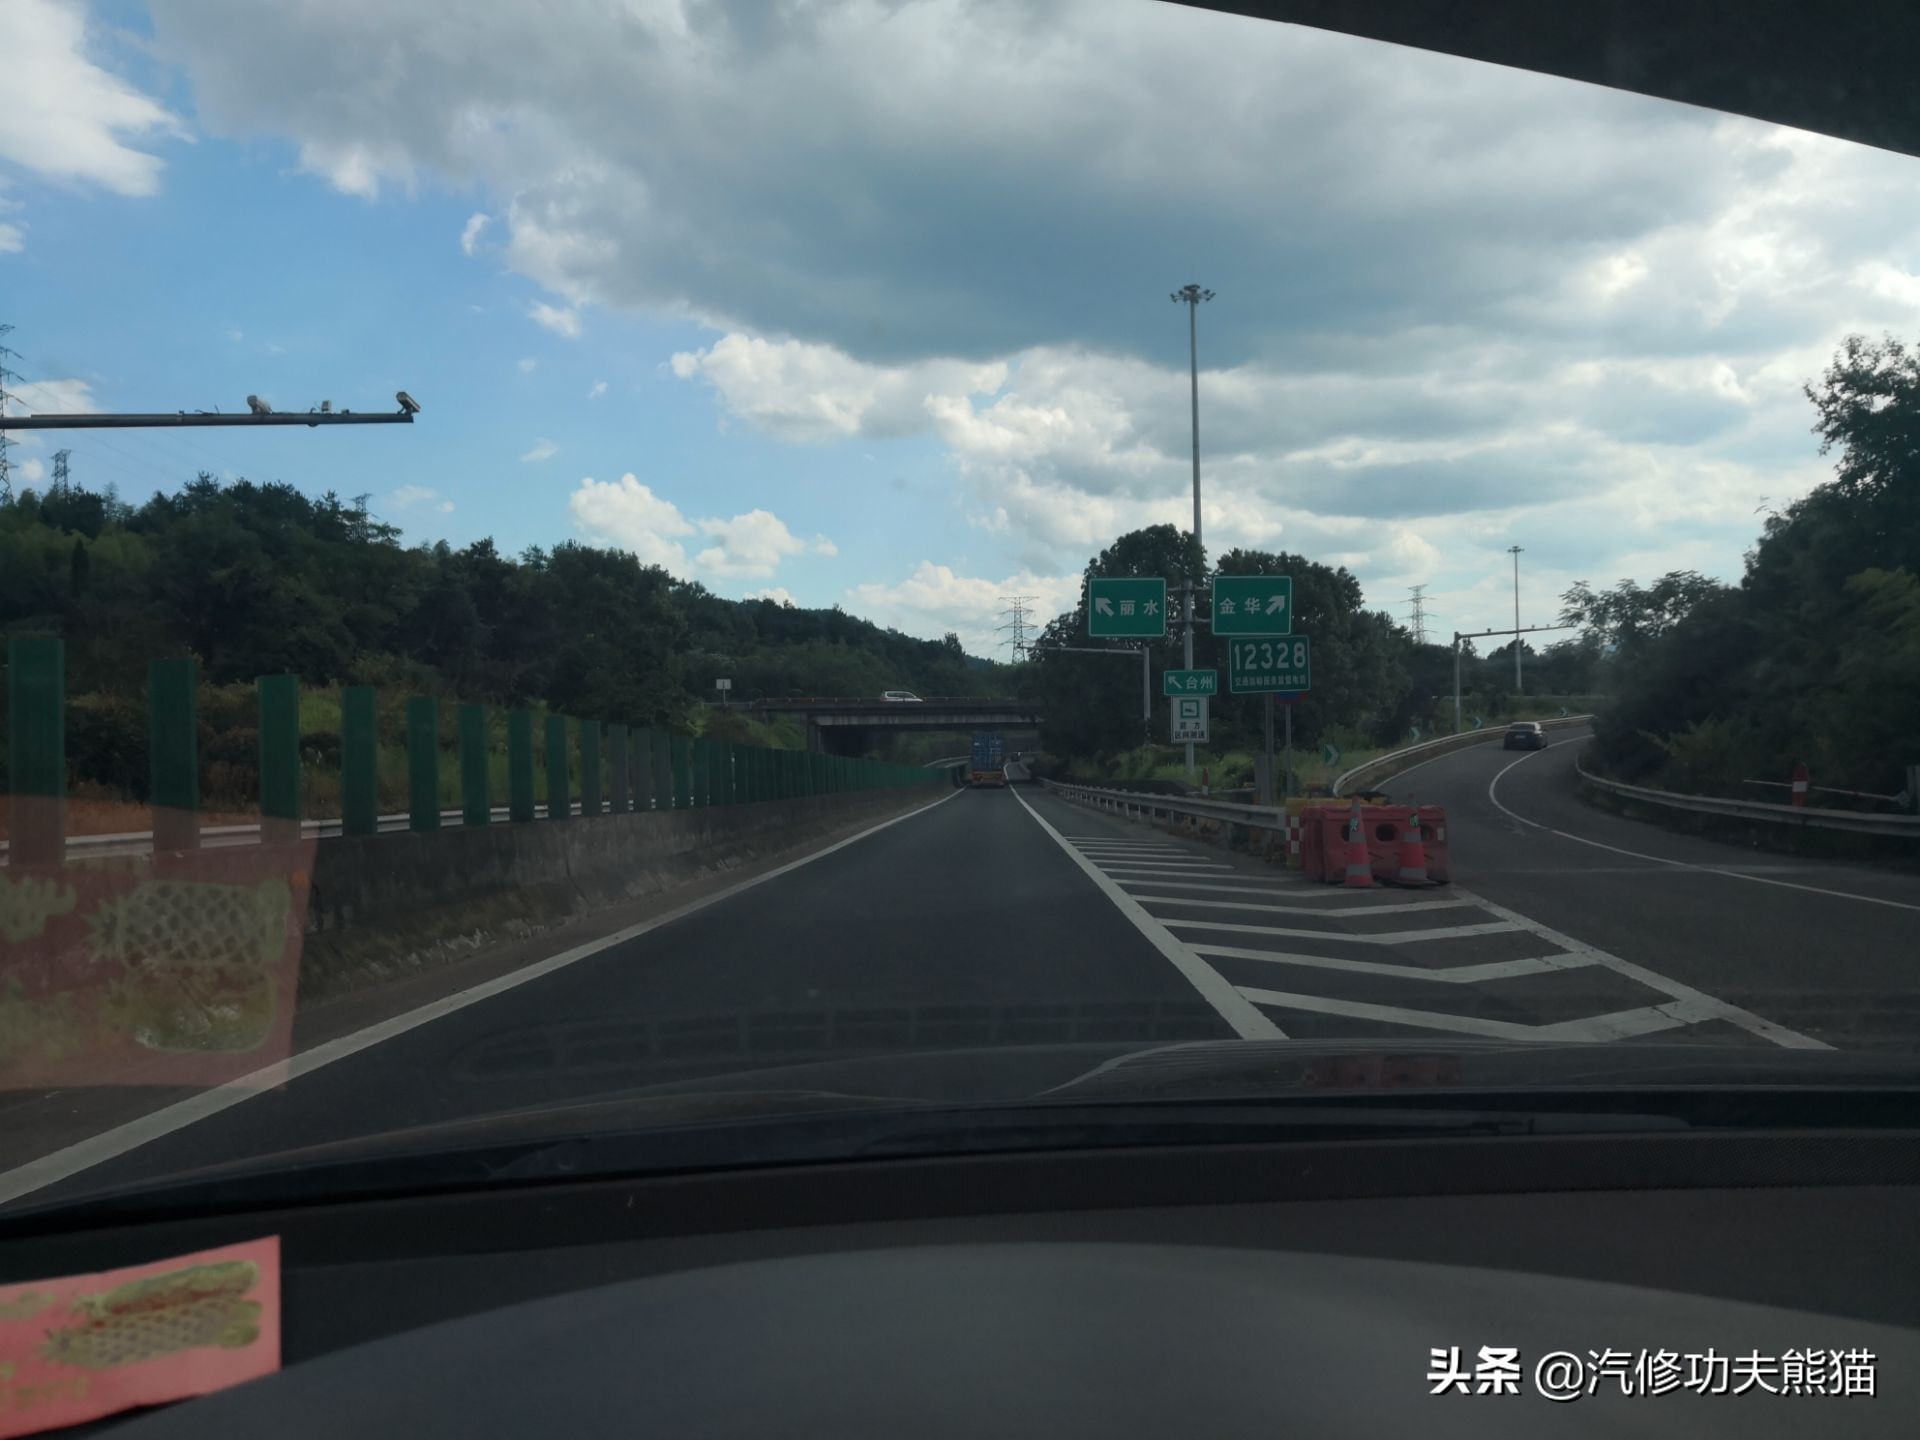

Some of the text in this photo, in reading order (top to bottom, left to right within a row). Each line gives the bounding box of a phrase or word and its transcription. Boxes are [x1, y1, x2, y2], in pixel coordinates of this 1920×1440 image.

[1119, 599, 1160, 616] 丽水
[1219, 597, 1262, 615] 金华
[1234, 642, 1306, 671] 12328
[1186, 675, 1213, 689] 台州
